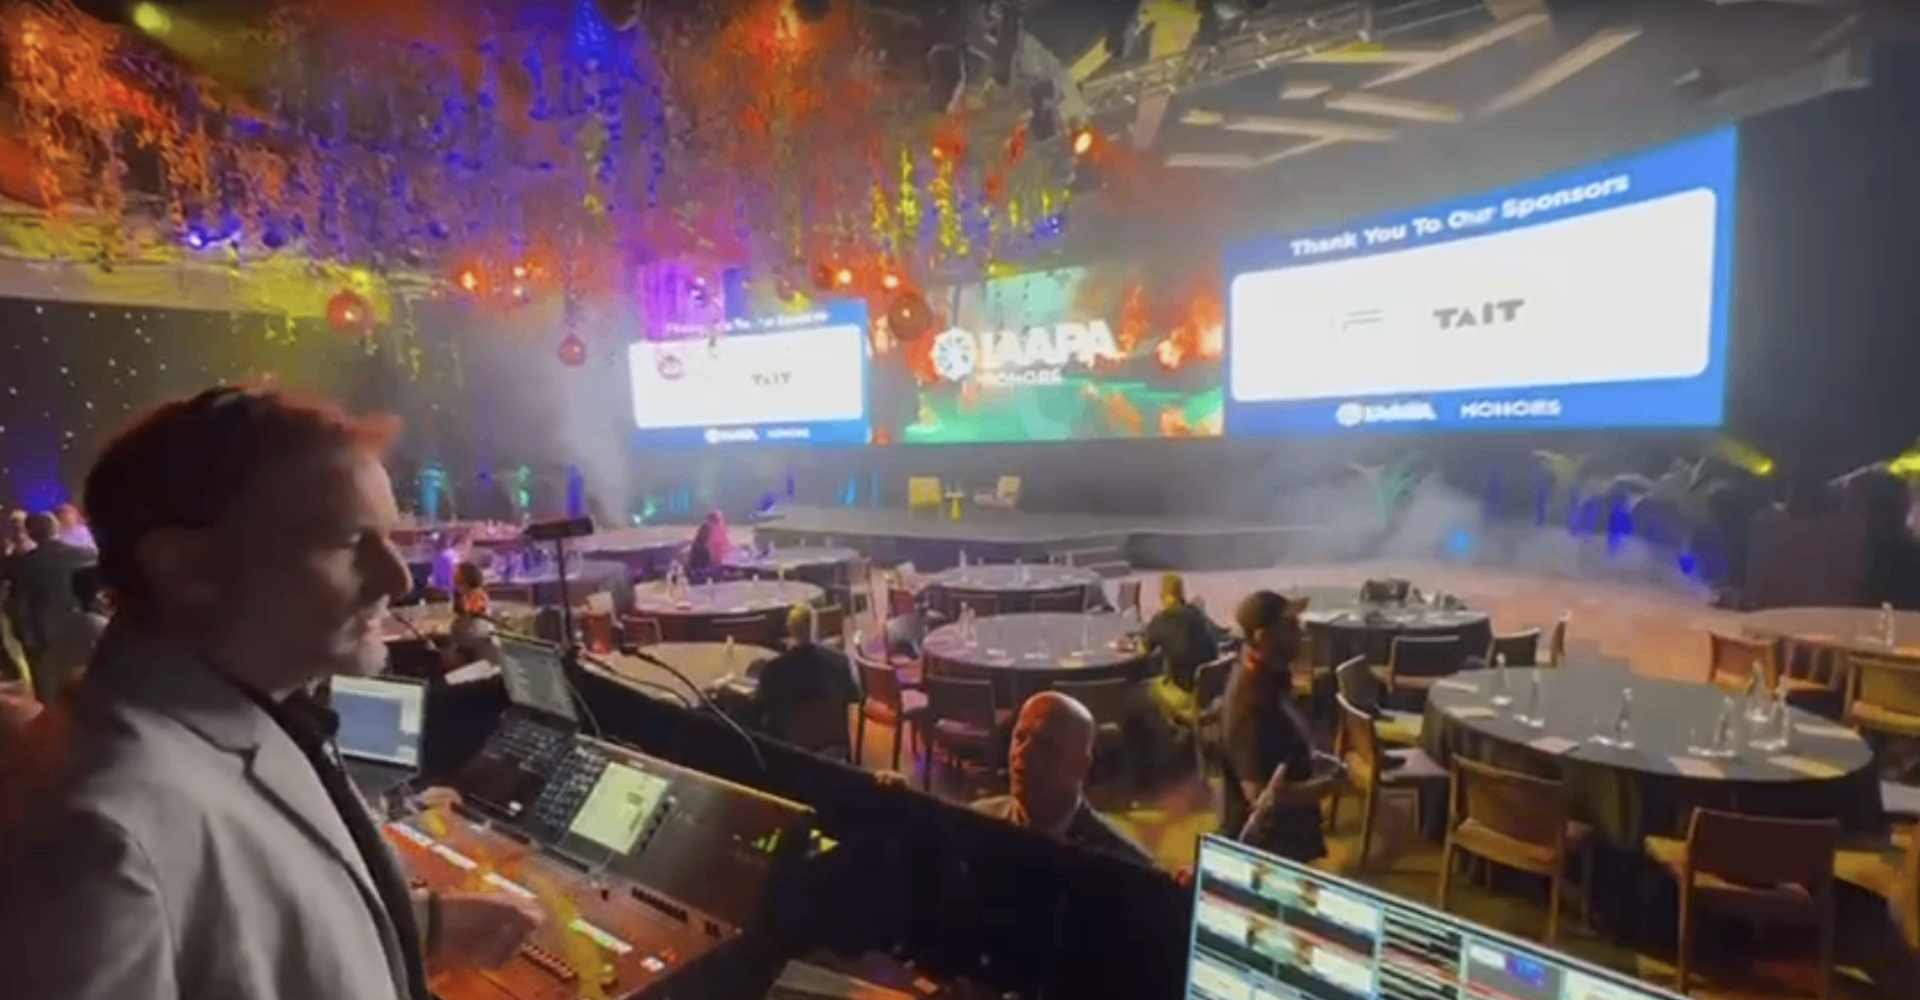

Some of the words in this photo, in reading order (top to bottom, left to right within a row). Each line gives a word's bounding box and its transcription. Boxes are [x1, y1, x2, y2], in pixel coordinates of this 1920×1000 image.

[1290, 231, 1358, 257] Thank
[1363, 224, 1407, 245] You
[1412, 216, 1442, 237] To
[1447, 206, 1497, 229] Our
[1501, 174, 1631, 219] Sponsors
[1433, 298, 1525, 330] TAIT
[979, 319, 1122, 369] IAAPA
